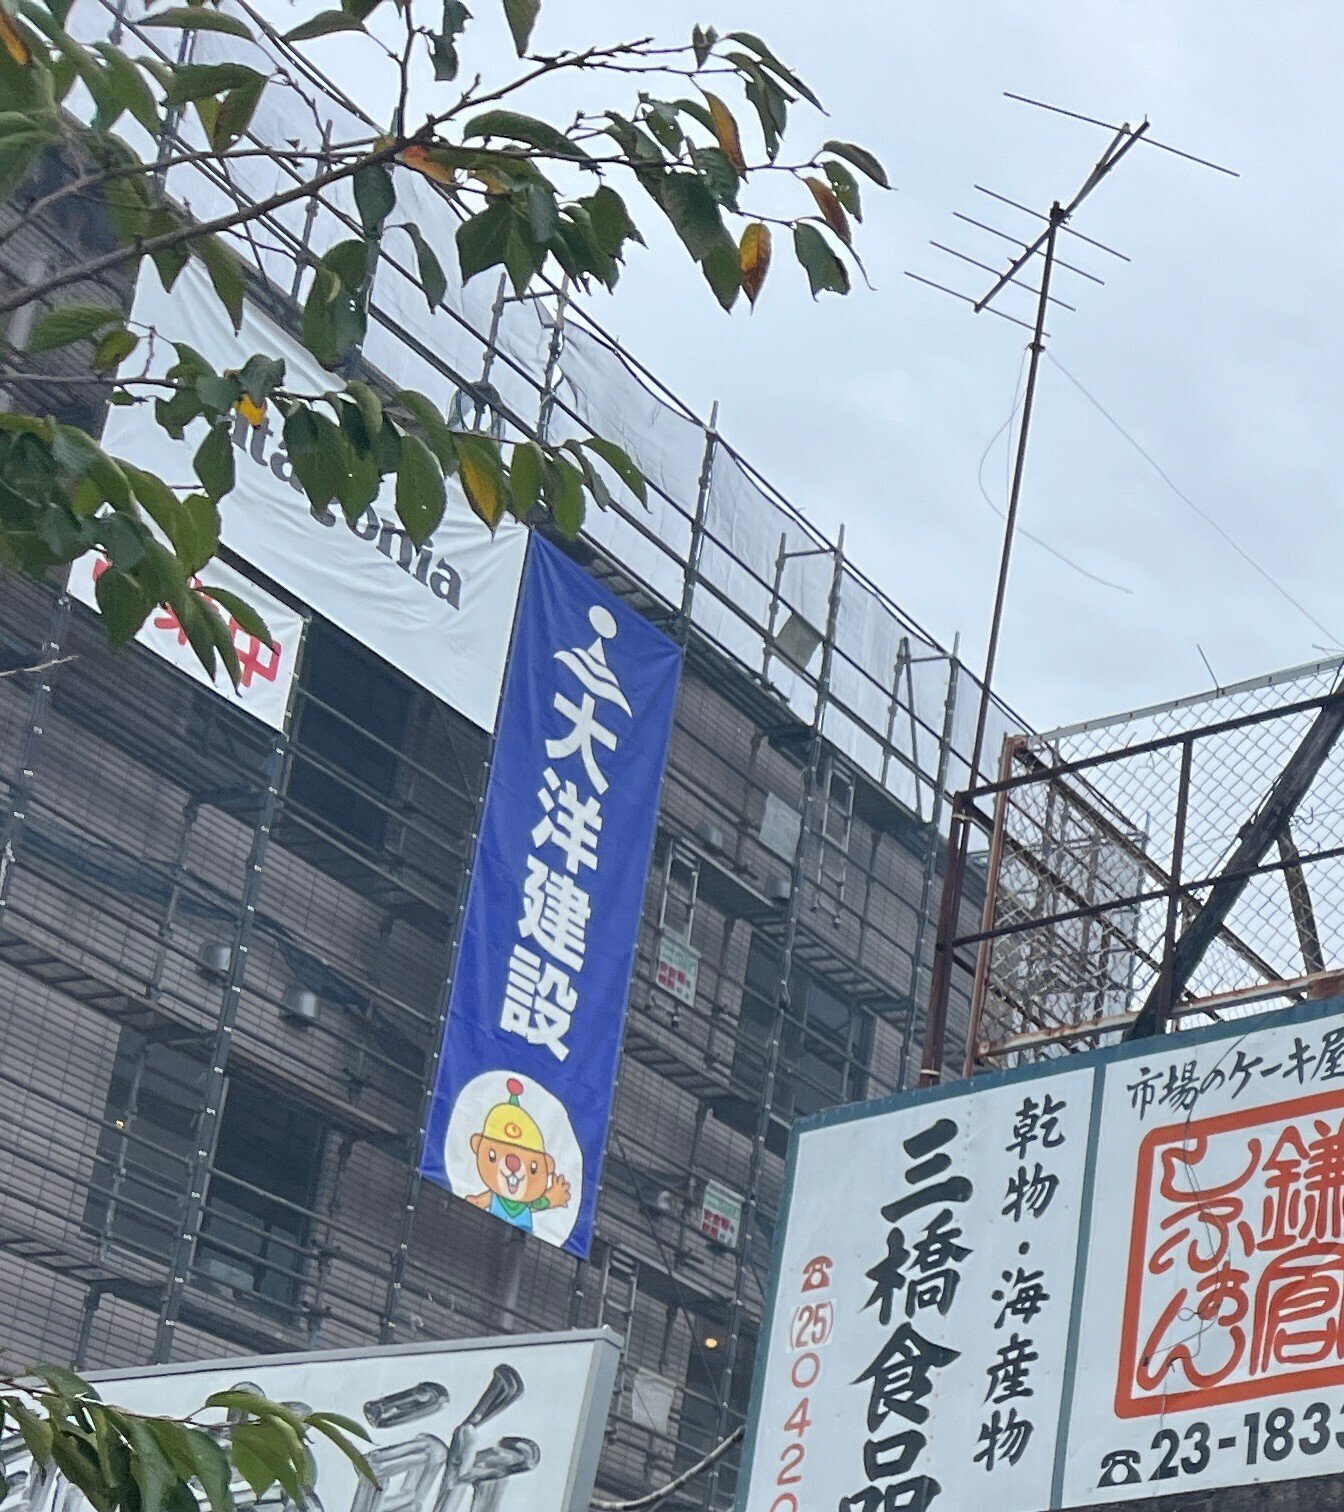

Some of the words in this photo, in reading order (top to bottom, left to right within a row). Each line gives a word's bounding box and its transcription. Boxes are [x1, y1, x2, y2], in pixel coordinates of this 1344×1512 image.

[498, 688, 620, 1063] 大洋建設
[974, 1094, 1067, 1472] 乾物・海産物
